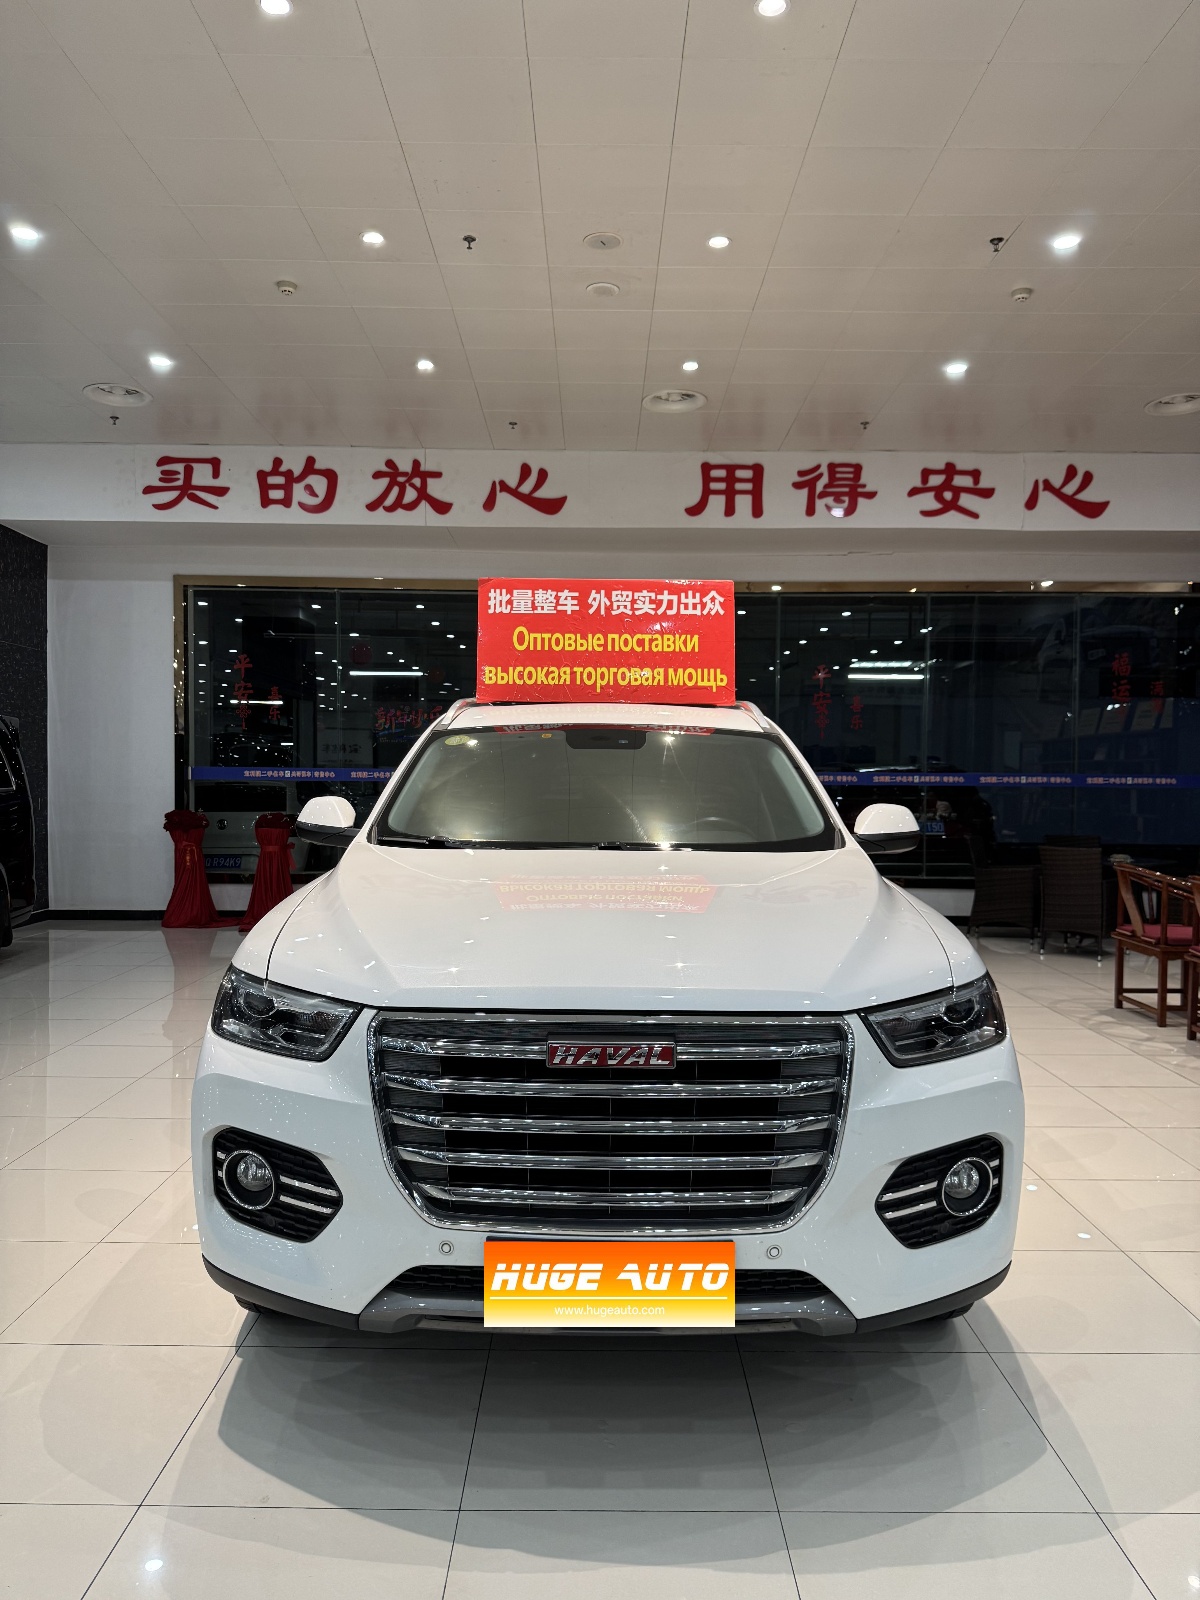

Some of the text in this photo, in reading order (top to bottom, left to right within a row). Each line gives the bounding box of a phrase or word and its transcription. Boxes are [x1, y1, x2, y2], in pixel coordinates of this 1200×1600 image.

[142, 455, 1110, 519] 买的放心 用得安心
[488, 589, 725, 616] 批量整车 外贸实力出众
[512, 626, 699, 652] Оптовые поставки
[484, 666, 728, 692] высокая торговая мощь
[811, 664, 833, 715] 平安
[552, 1045, 671, 1065] HAVAL
